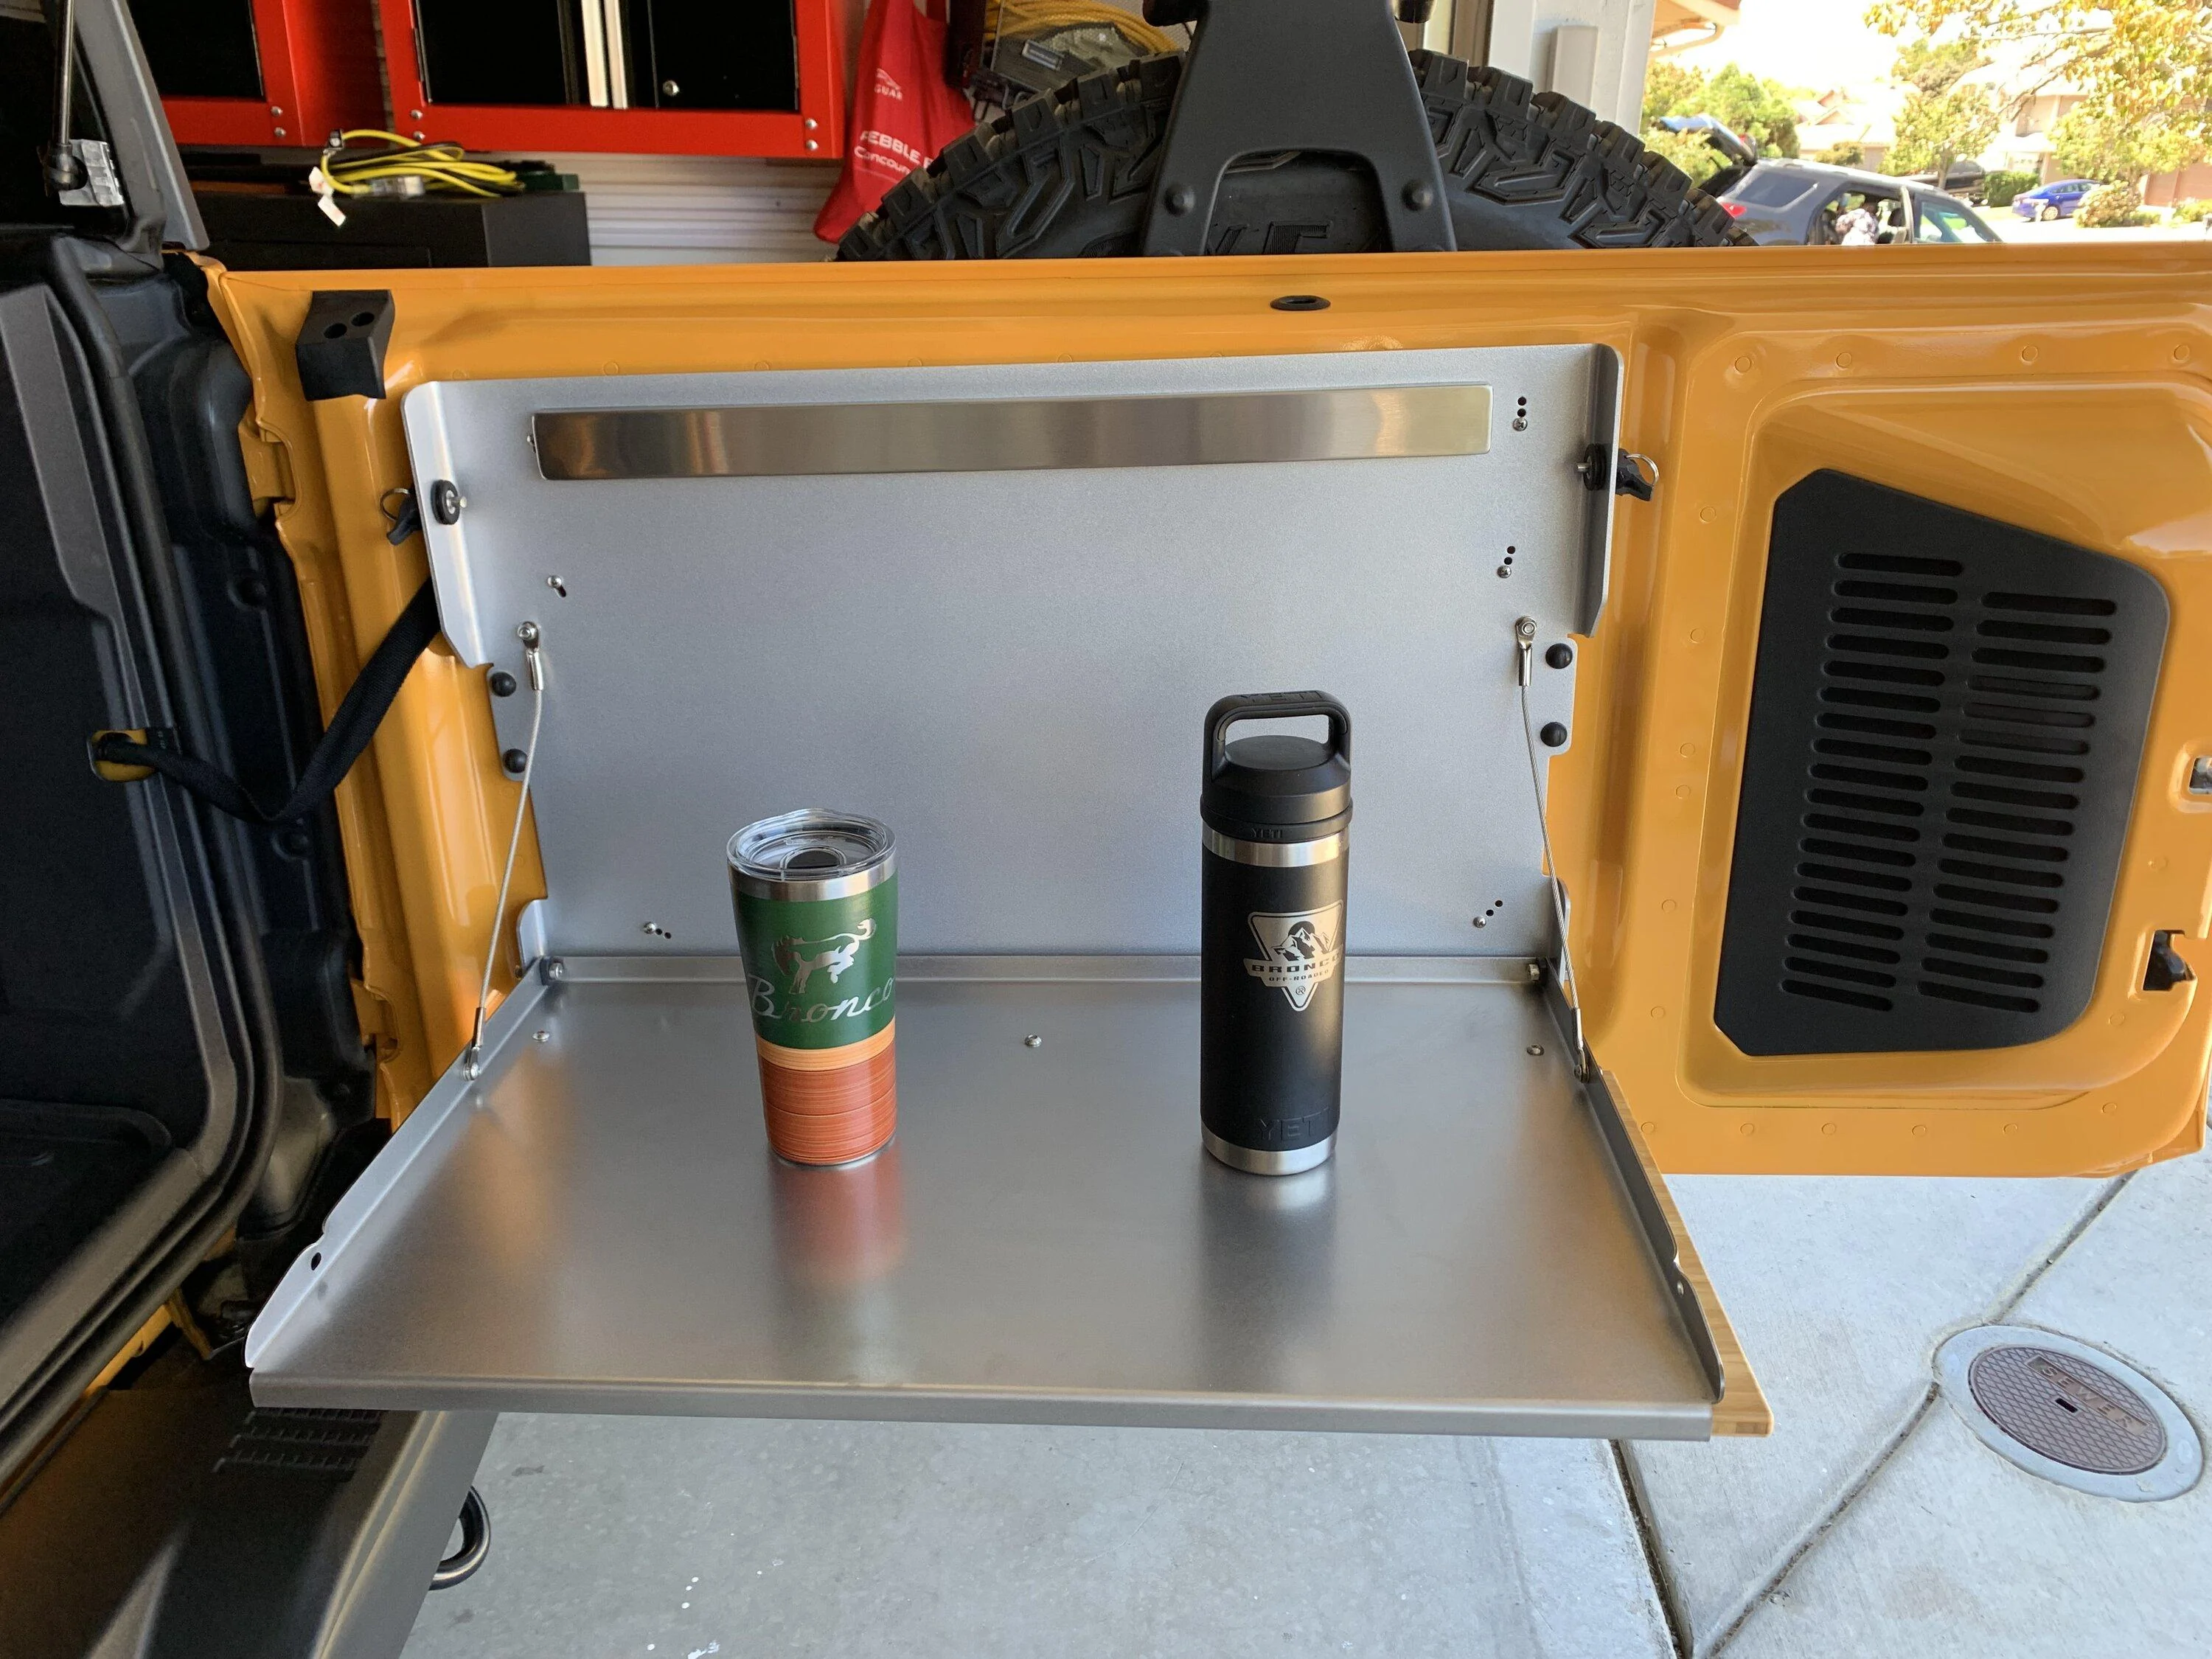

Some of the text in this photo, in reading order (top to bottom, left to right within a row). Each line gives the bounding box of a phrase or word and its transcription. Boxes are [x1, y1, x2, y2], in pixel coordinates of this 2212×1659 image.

[860, 131, 921, 165] PEBBLE
[1251, 827, 1283, 838] YETI
[1251, 953, 1339, 973] BRONCO
[746, 973, 894, 1023] Bronco
[2039, 1366, 2134, 1428] SEWER
